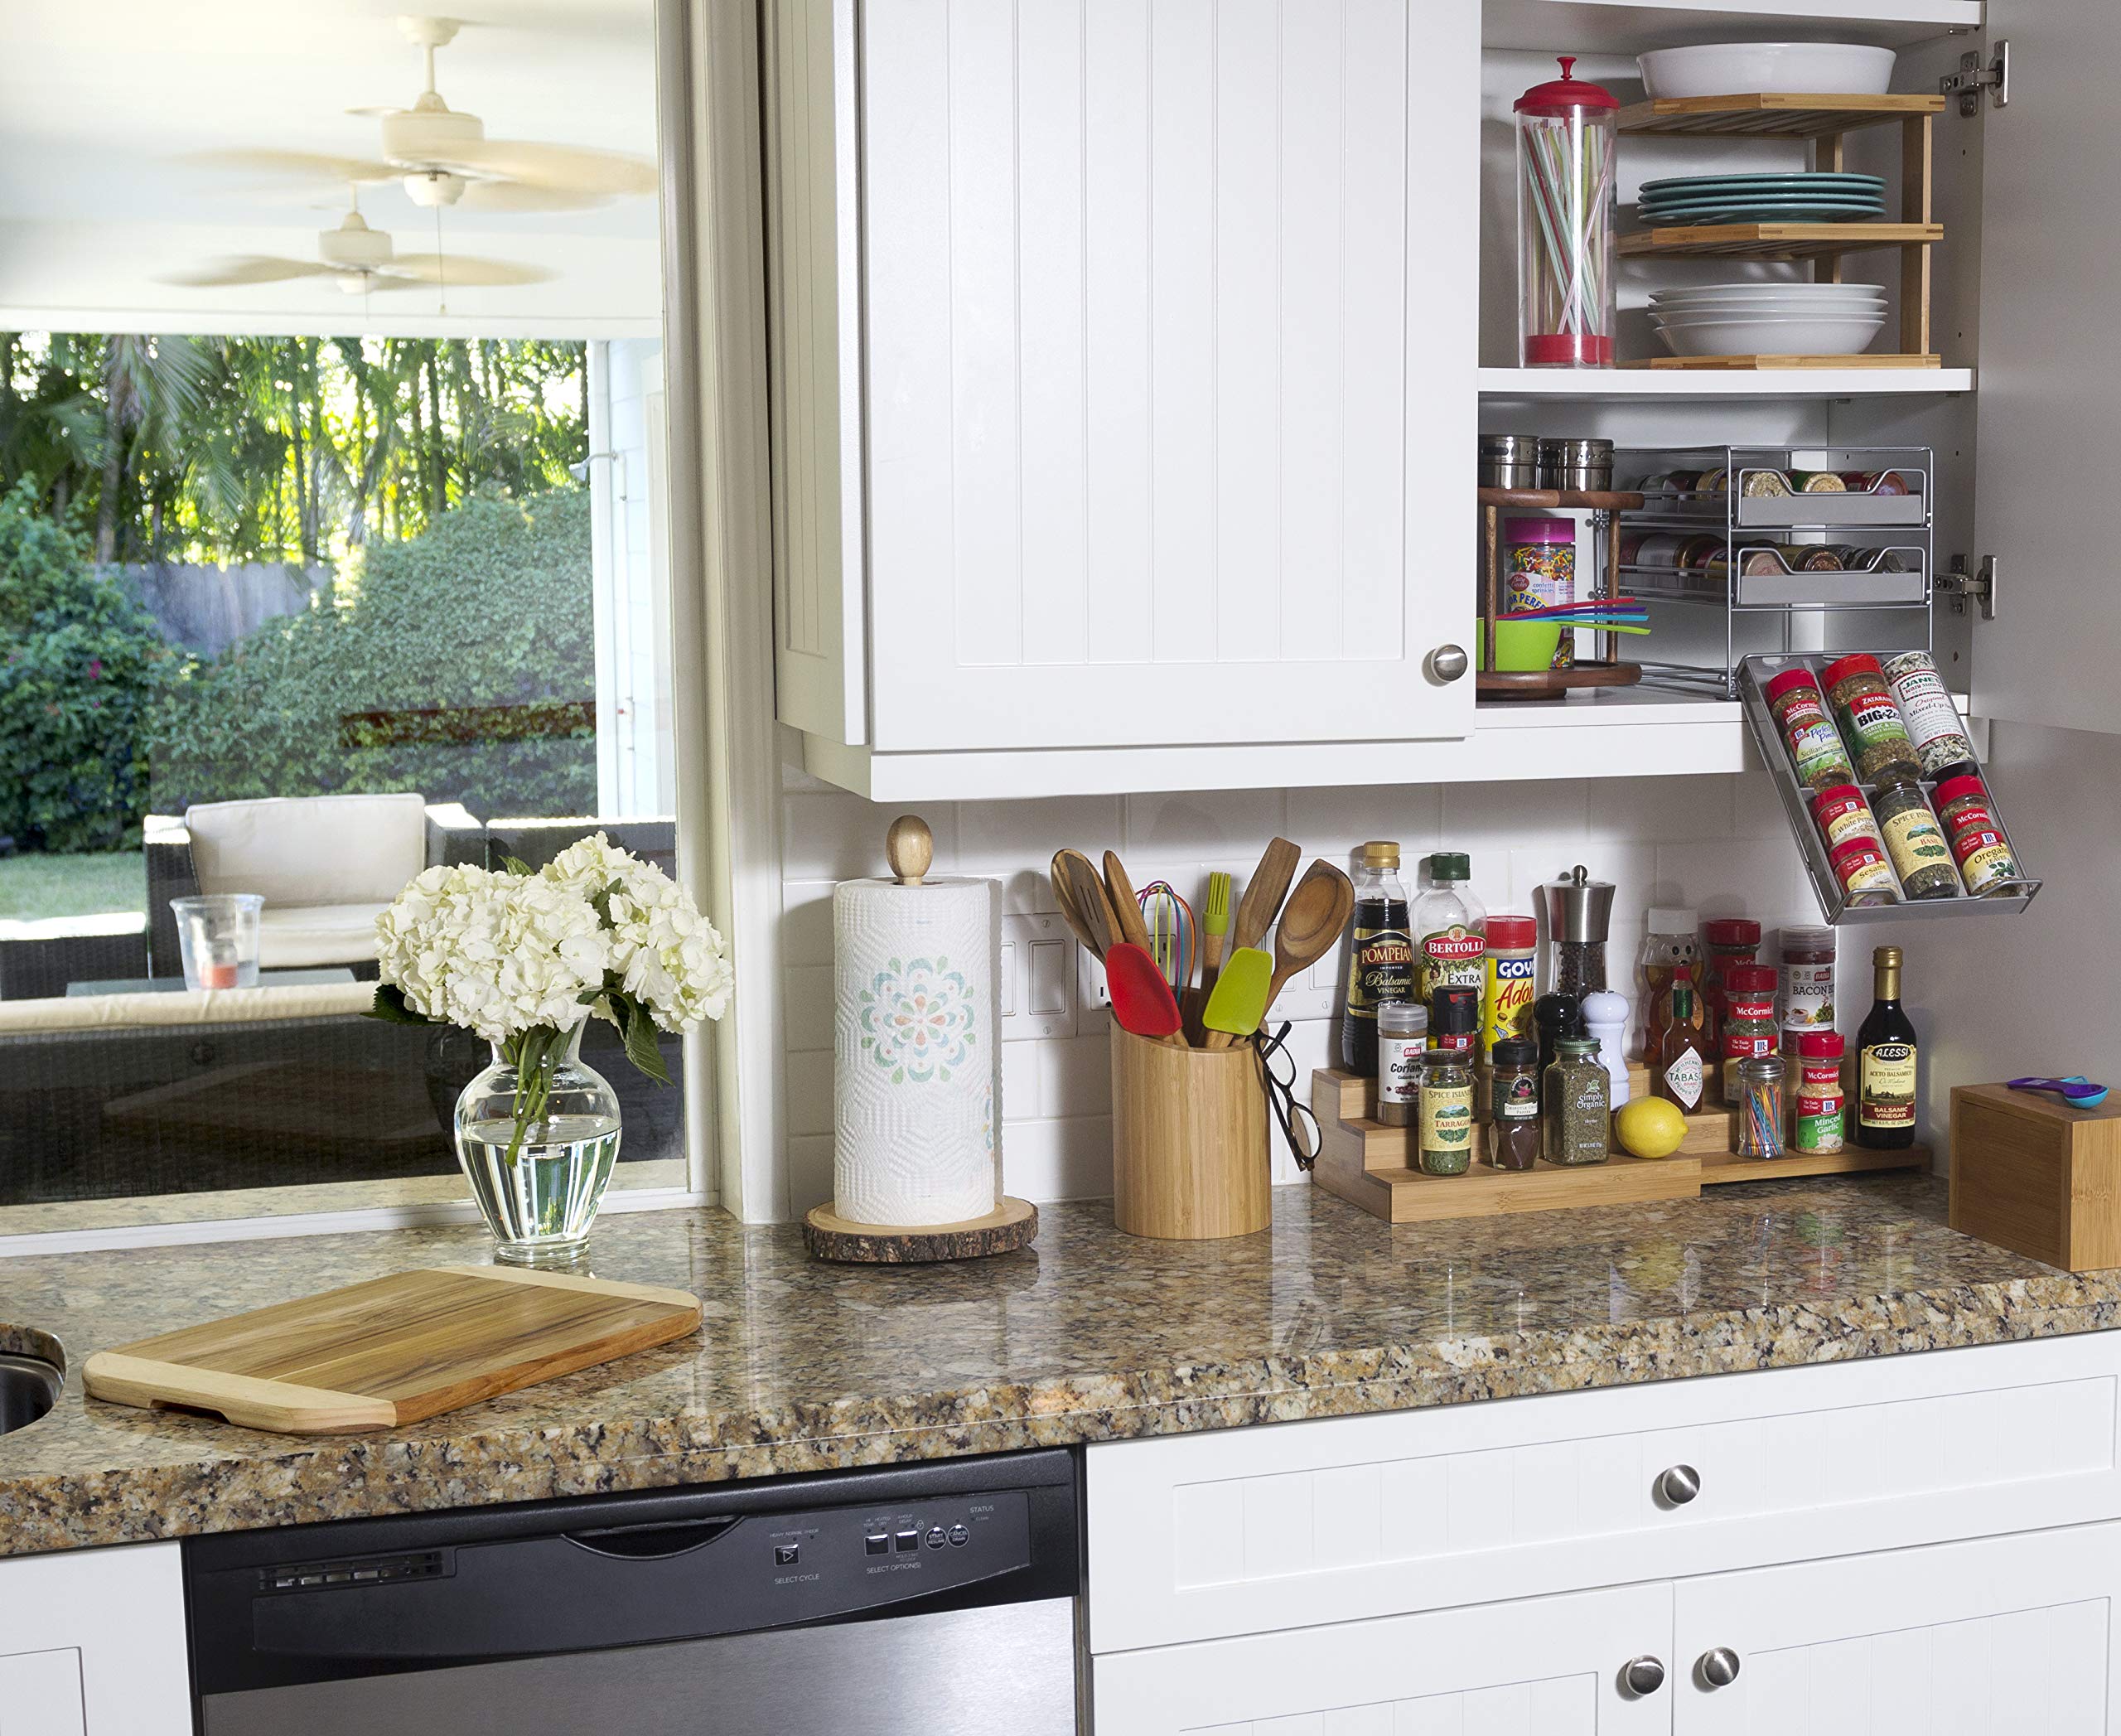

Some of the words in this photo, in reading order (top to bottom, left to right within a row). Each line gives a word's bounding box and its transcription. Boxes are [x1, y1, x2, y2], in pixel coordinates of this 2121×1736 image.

[1801, 747, 1823, 758] Sicilian
[1838, 818, 1857, 834] White
[1892, 814, 1915, 827] SPICE
[1859, 864, 1887, 879] Sesame
[1428, 941, 1484, 954] BERTOLLI
[1499, 961, 1534, 978] GOY
[1365, 970, 1412, 987] Balsamic
[1447, 973, 1481, 984] EXTRA
[1495, 979, 1534, 1011] Adob
[1793, 985, 1827, 996] BACON
[1876, 1048, 1909, 1057] ALESSI
[1390, 1063, 1423, 1073] Corian
[1428, 1090, 1451, 1099] SPICE
[1578, 1093, 1604, 1103] Simply
[1577, 1100, 1606, 1110] Organic
[1815, 1113, 1841, 1127] Minced
[1817, 1123, 1839, 1134] Garlic
[969, 1505, 994, 1514] STATUS
[866, 1565, 889, 1574] SELECT
[890, 1562, 921, 1571] OPTION(S)
[774, 1575, 798, 1585] SELECT
[799, 1573, 820, 1582] CYCLE
